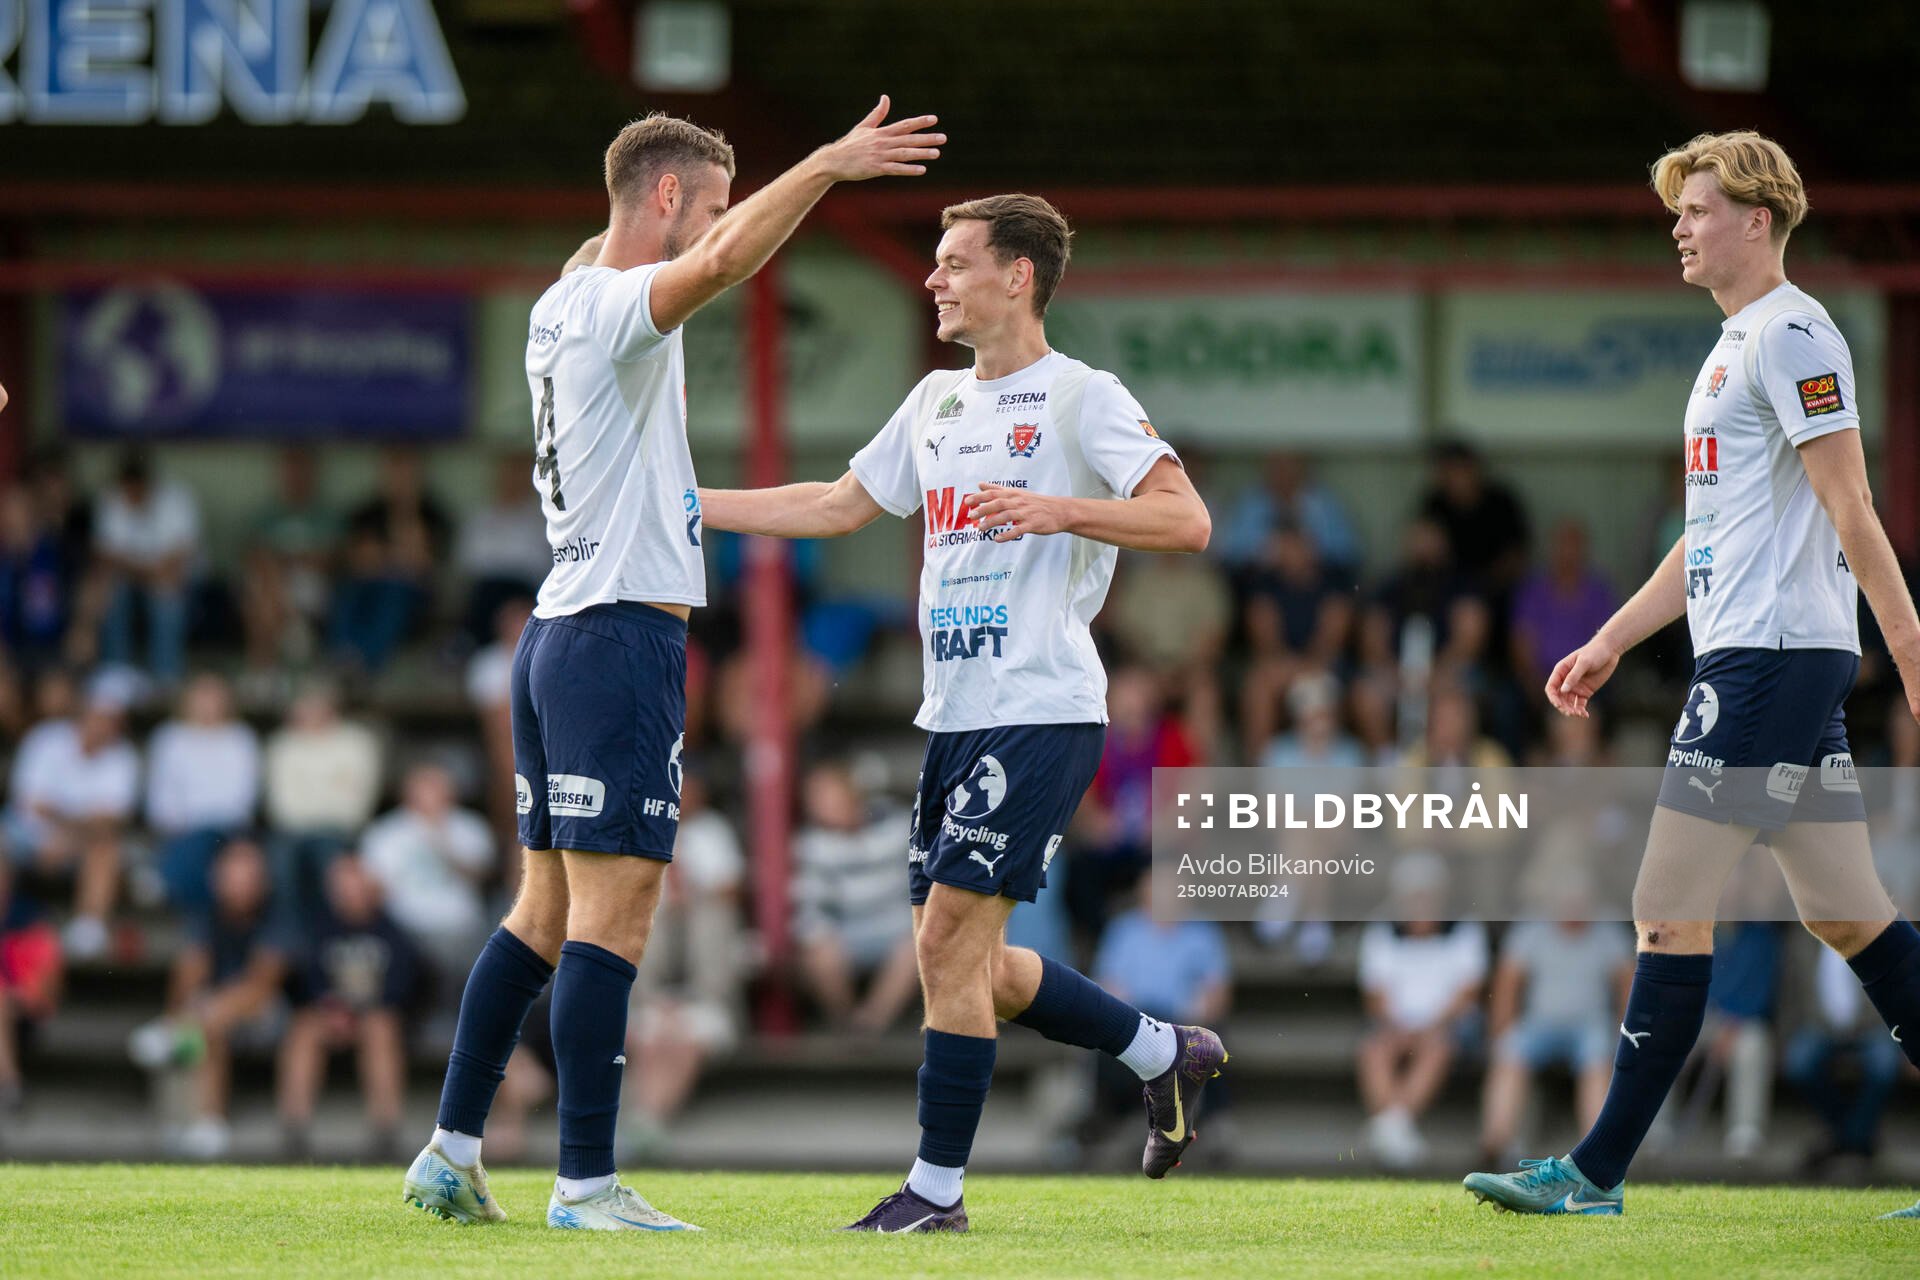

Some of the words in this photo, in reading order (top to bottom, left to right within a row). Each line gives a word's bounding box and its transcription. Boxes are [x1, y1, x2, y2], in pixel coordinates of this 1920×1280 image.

[0, 0, 468, 124] ENA
[1009, 392, 1046, 404] STENA
[1806, 395, 1839, 408] KVANTUM
[996, 403, 1044, 414] RECYCLING
[536, 376, 566, 512] 4
[959, 444, 992, 455] stadium
[643, 797, 664, 817] HF
